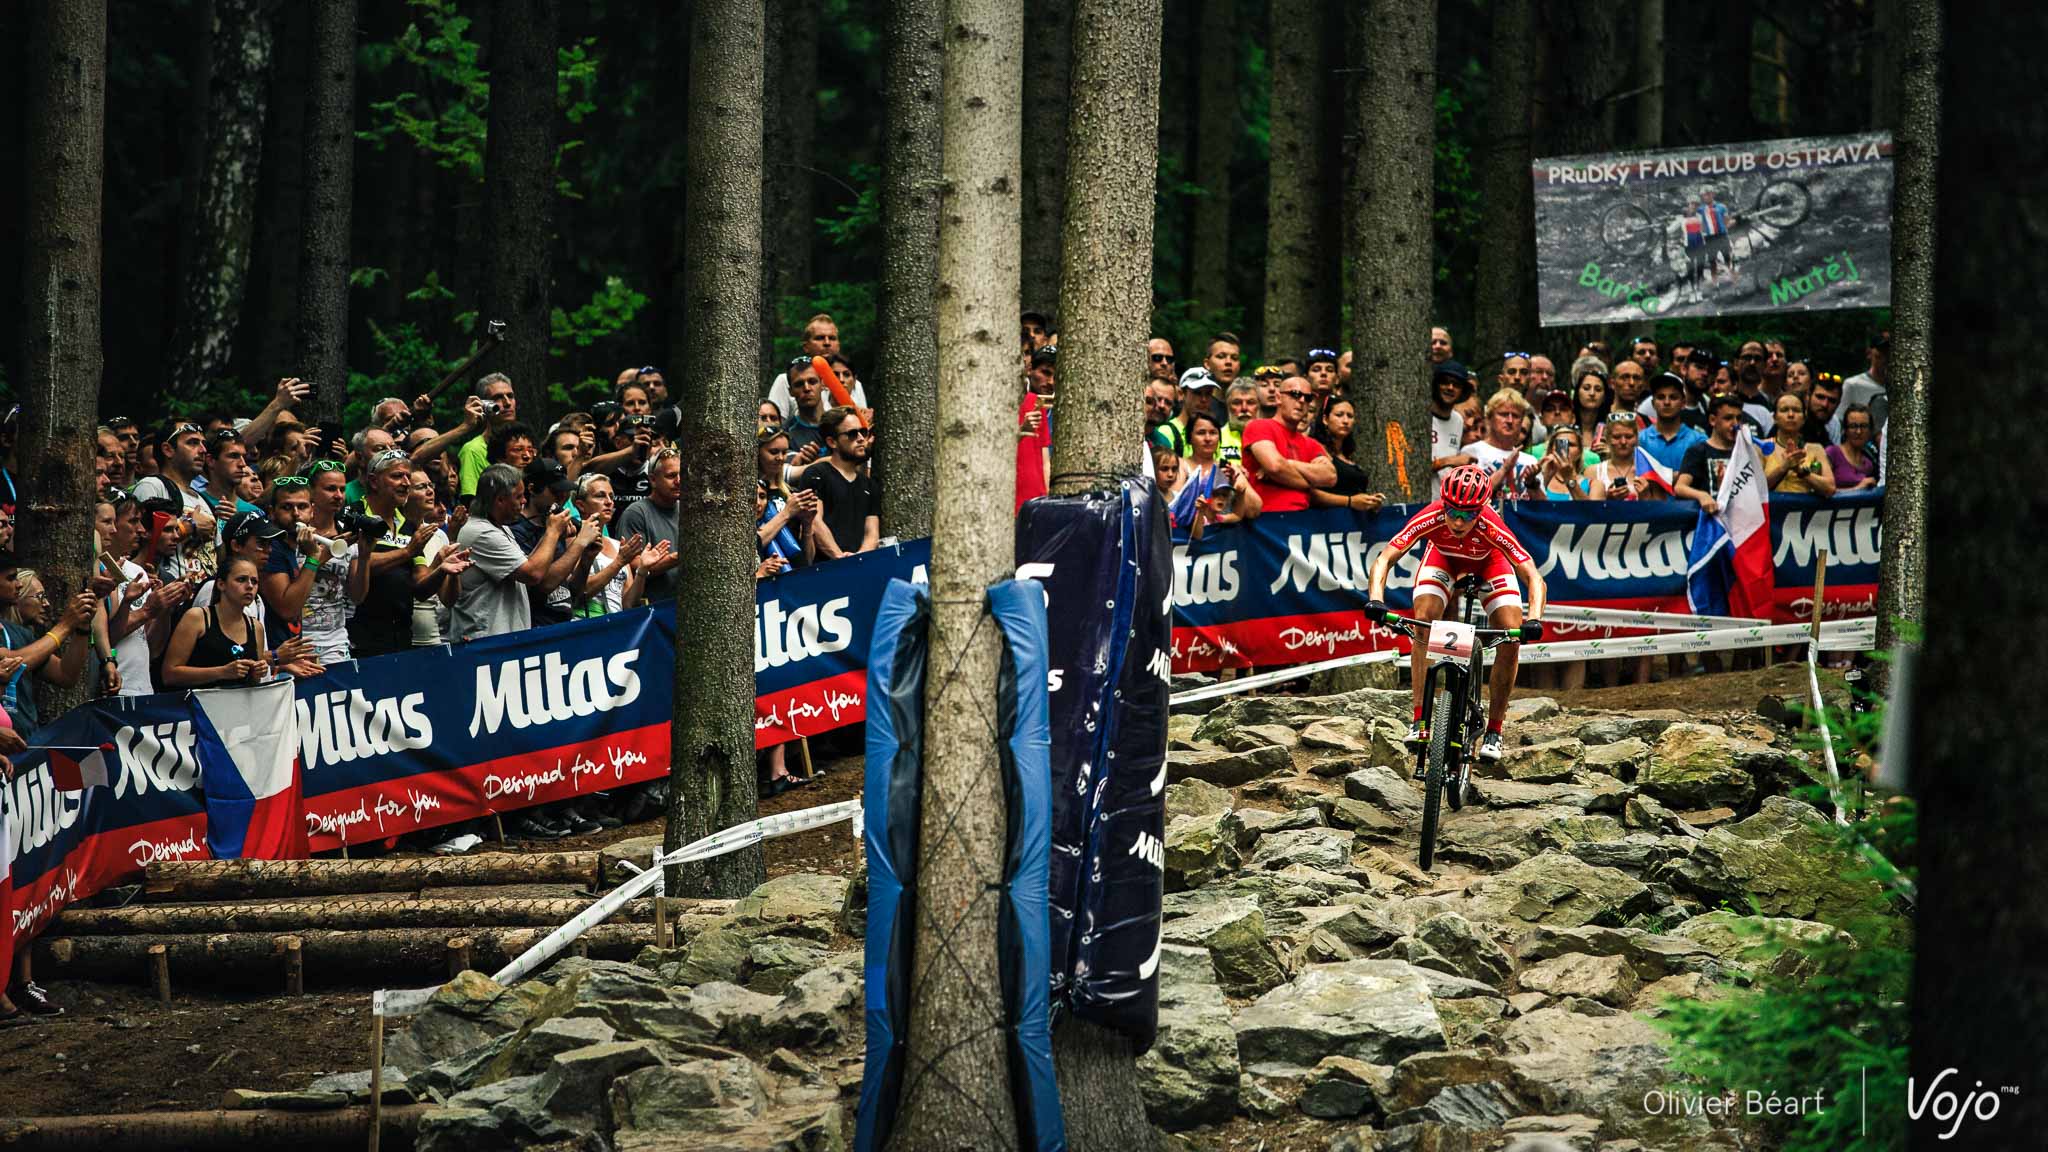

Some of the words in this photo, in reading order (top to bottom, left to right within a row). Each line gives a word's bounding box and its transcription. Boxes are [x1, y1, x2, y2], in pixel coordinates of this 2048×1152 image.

[1548, 161, 1630, 186] PRuDKý
[1639, 157, 1688, 180] FAN
[1698, 151, 1756, 174] CLUB
[1768, 142, 1881, 169] OSTRAVA
[1578, 261, 1661, 315] Barča
[1768, 250, 1860, 306] Matěj
[1402, 517, 1436, 541] postnord
[1538, 522, 1696, 581] Mita
[1773, 507, 1882, 568] Mit
[1172, 545, 1240, 607] tas
[1188, 635, 1216, 668] for
[1218, 635, 1239, 665] You
[1279, 620, 1366, 655] Designed
[1443, 631, 1458, 650] 2
[469, 648, 641, 739] Mitas
[788, 697, 823, 737] for
[823, 689, 861, 721] You
[295, 687, 433, 770] Mitas
[115, 719, 202, 800] Mit
[483, 758, 565, 801] Designed
[571, 753, 605, 791] for
[607, 745, 647, 779] You
[306, 798, 371, 840] Designed
[374, 792, 407, 832] for
[407, 788, 440, 823] You
[128, 827, 200, 867] Designed
